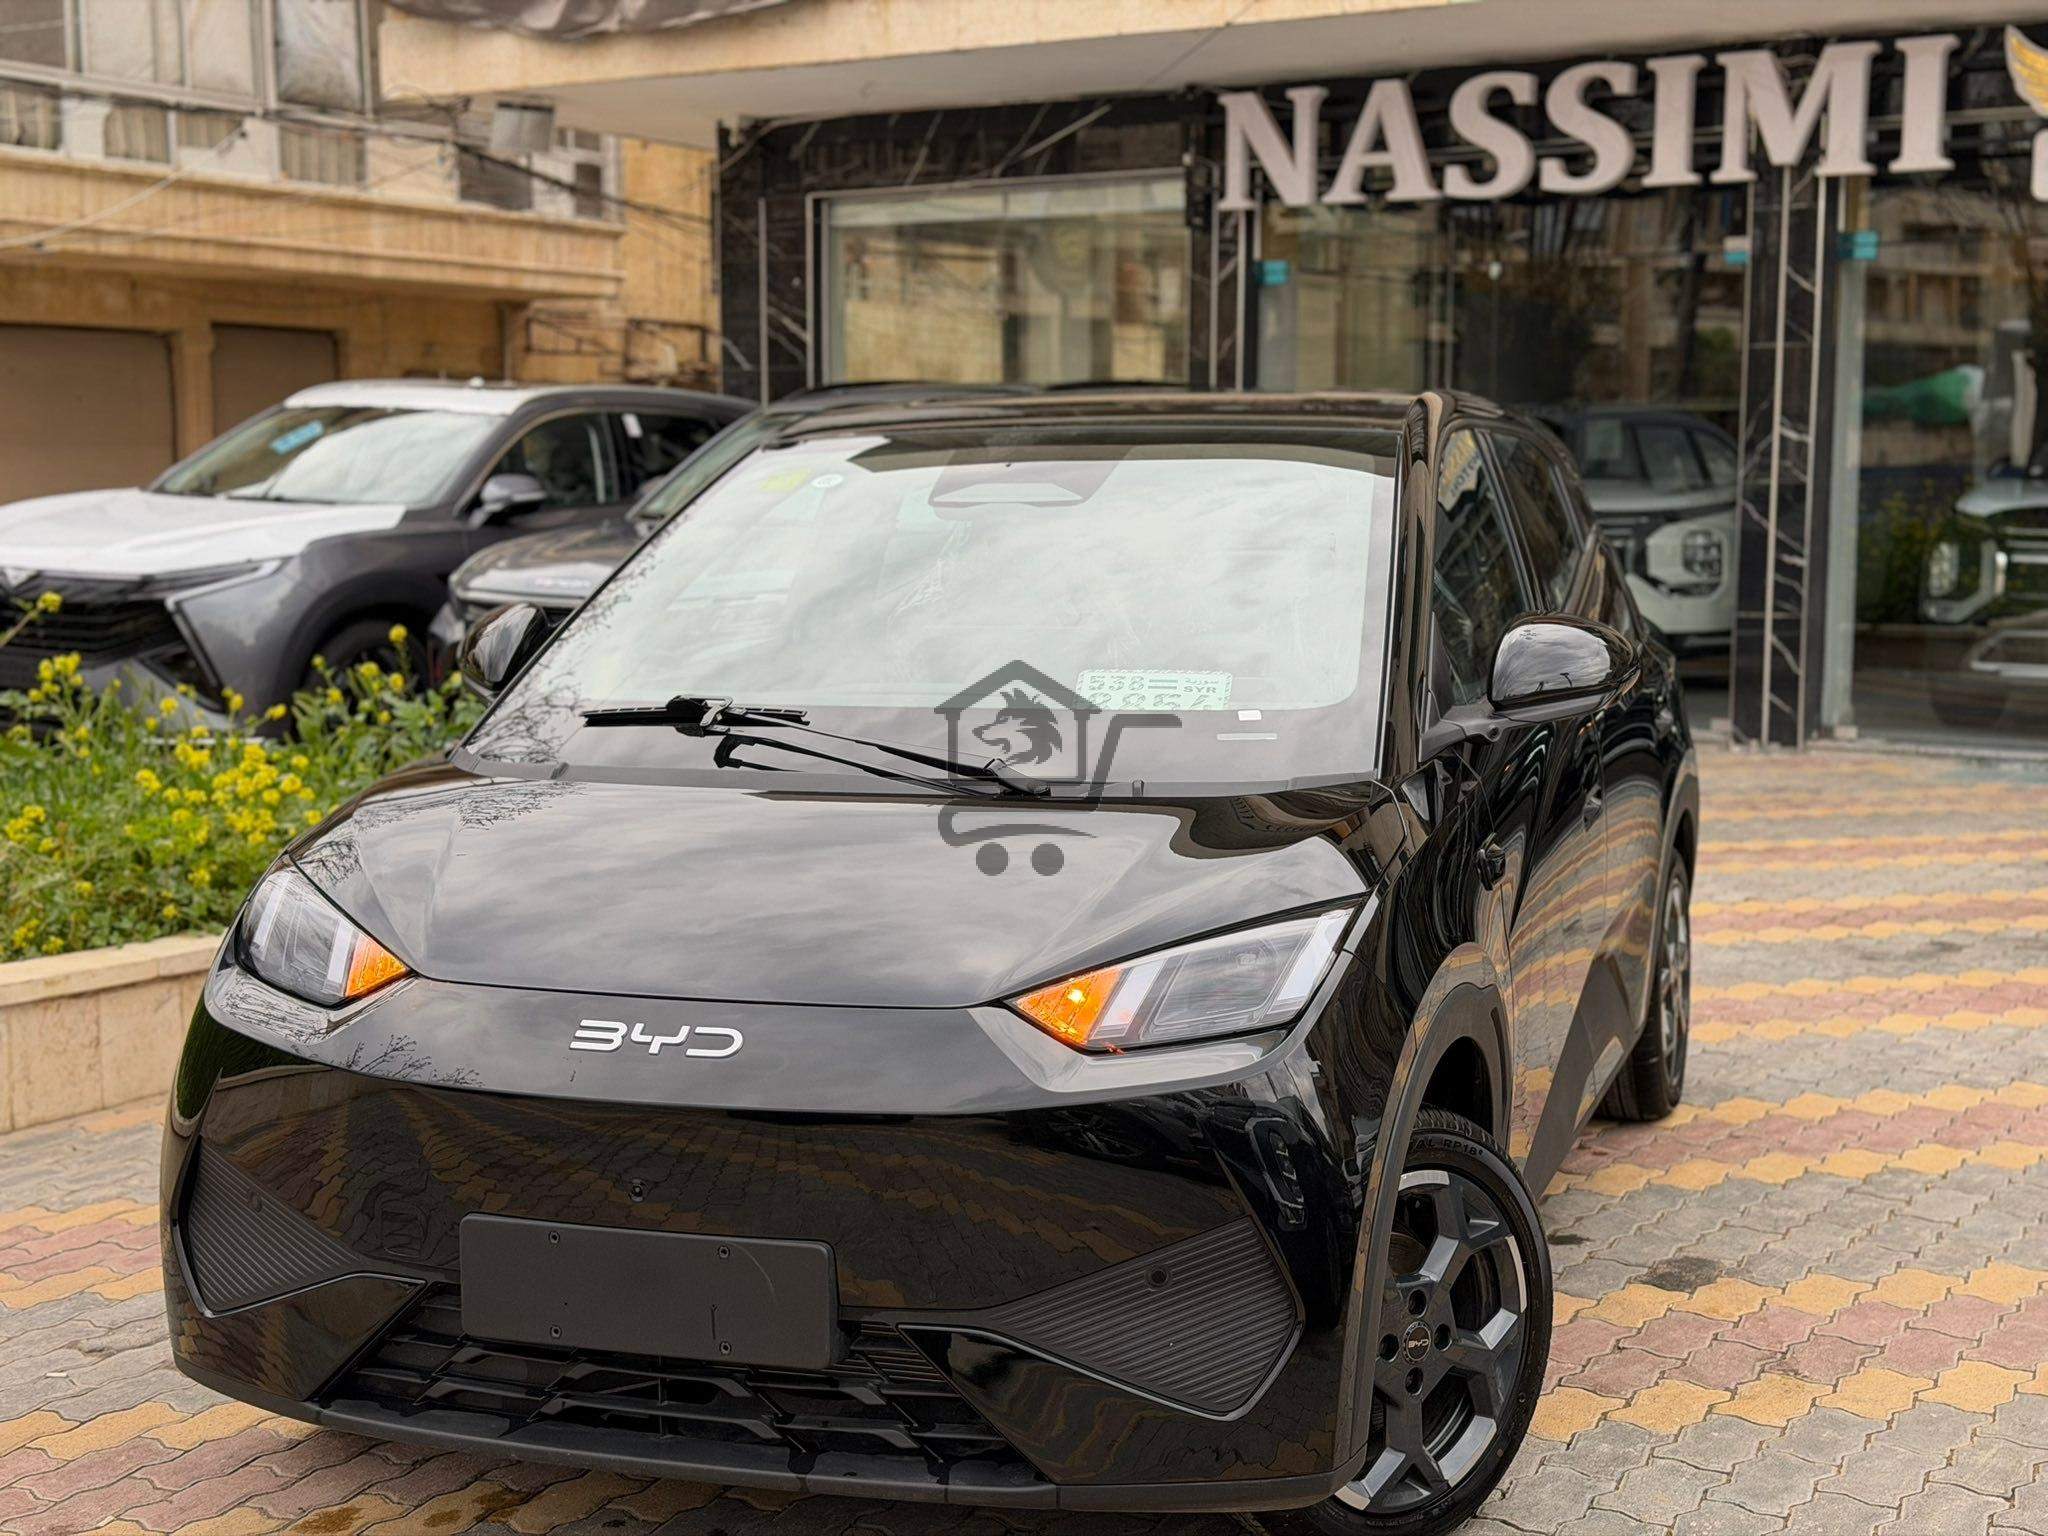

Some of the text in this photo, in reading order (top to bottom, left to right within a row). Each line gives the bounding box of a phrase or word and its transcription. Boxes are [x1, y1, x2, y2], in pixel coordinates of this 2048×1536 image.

[1216, 33, 1960, 211] NASSIMI
[1183, 686, 1217, 694] SYR
[569, 1019, 744, 1058] BYD
[1408, 1338, 1429, 1348] BYD
